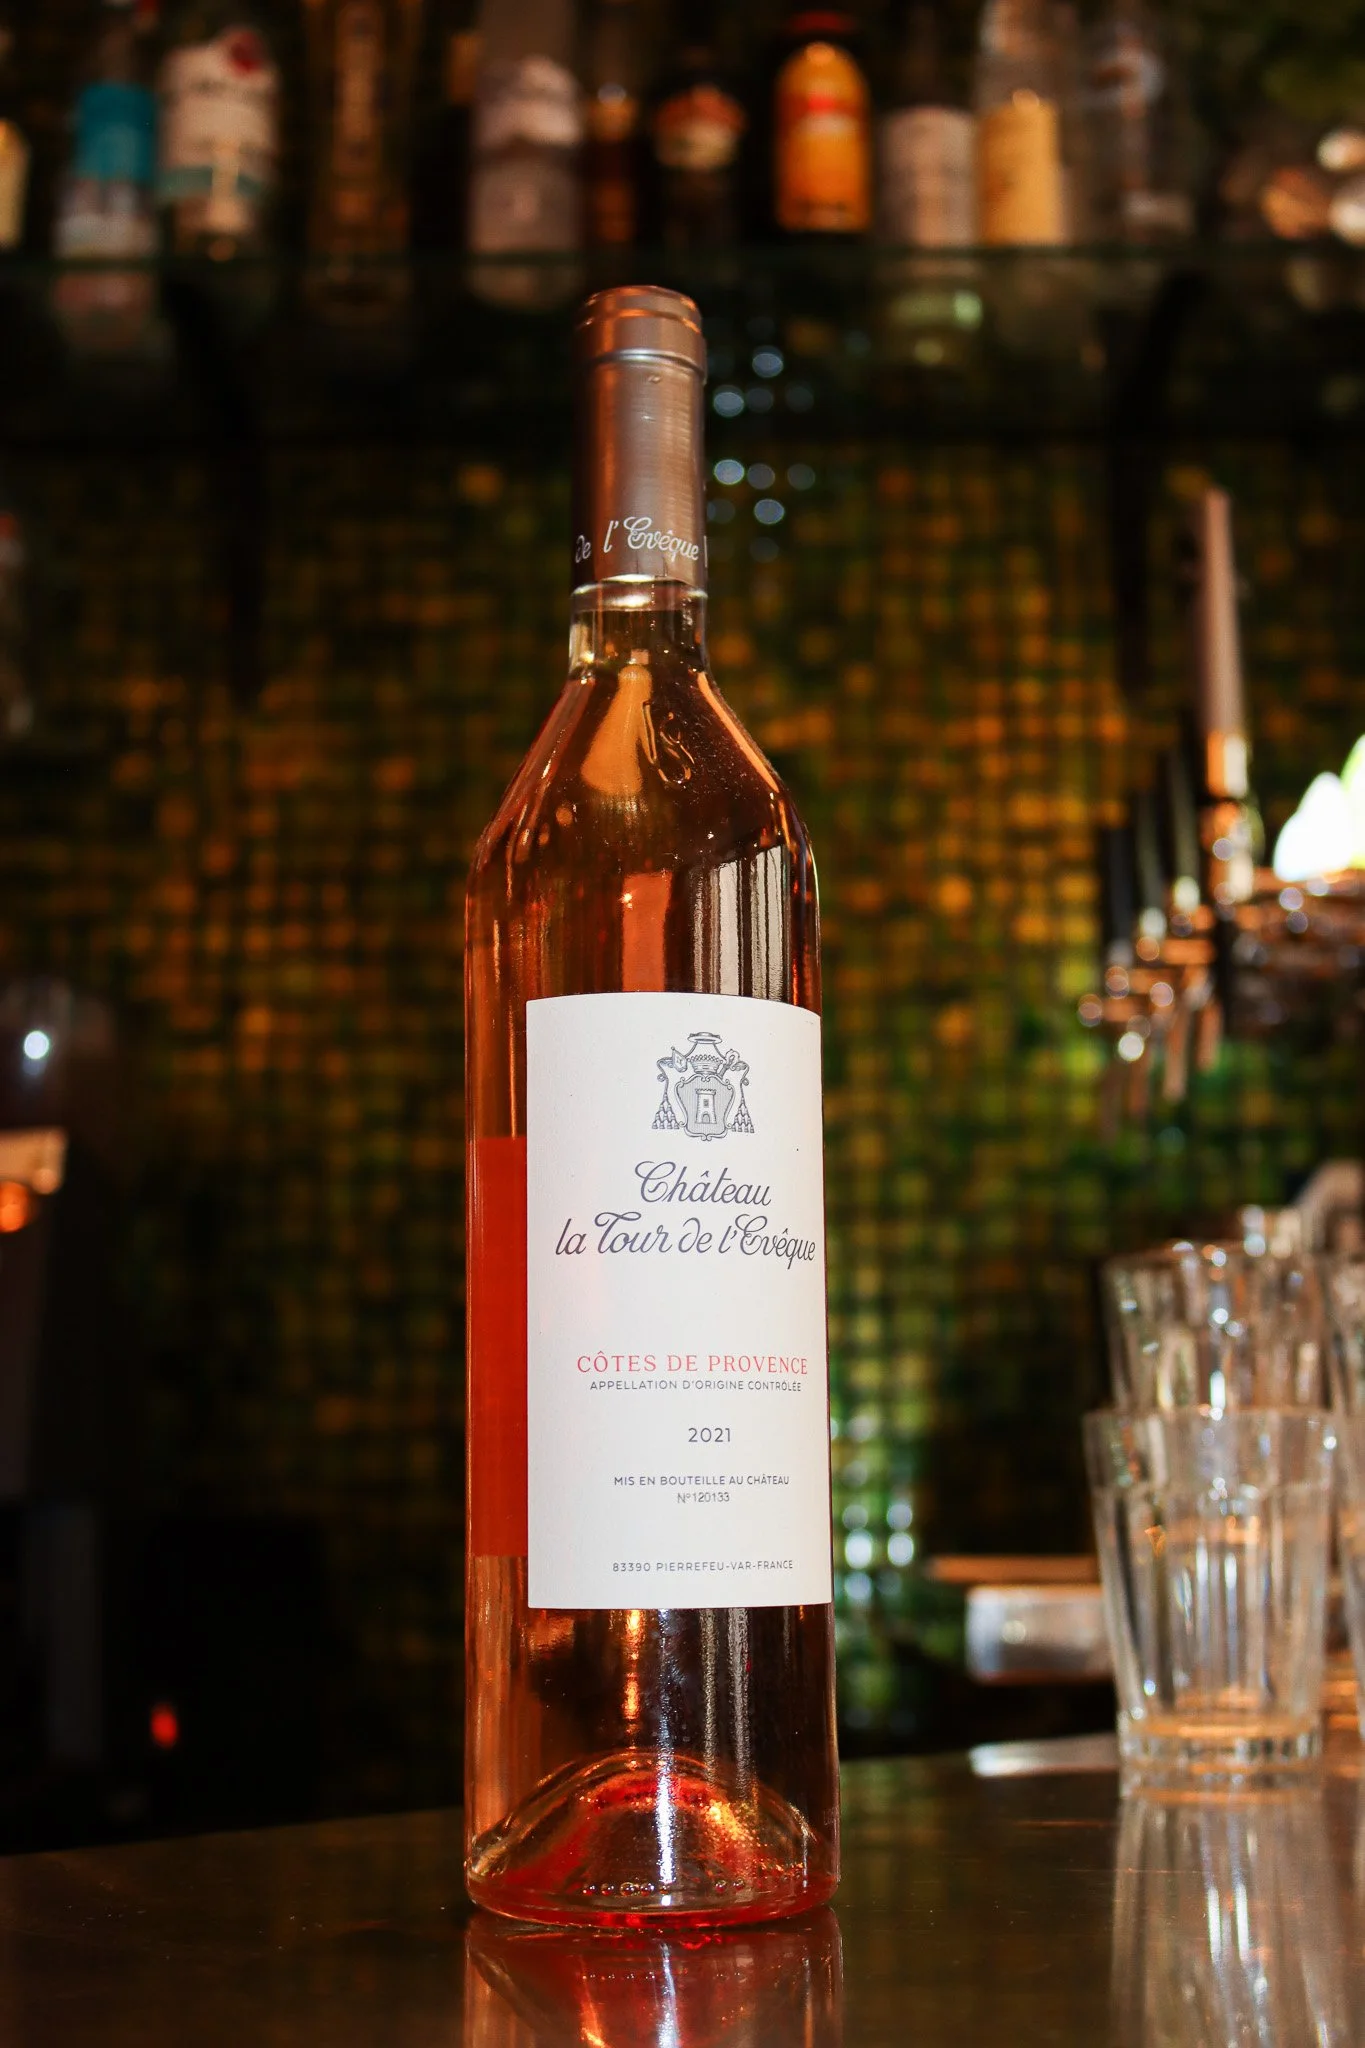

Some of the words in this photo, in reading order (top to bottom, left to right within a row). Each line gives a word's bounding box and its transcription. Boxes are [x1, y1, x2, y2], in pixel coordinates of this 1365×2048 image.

[635, 1160, 771, 1206] Château
[555, 1217, 587, 1256] la
[594, 1211, 672, 1255] Tour
[678, 1216, 713, 1254] de
[717, 1213, 816, 1270] l'Evêque
[577, 1350, 657, 1374] CÔTES
[667, 1354, 698, 1372] DE
[708, 1354, 808, 1375] PROVENCE
[589, 1379, 678, 1391] APPELLATION
[682, 1379, 744, 1390] D'ORIGINE
[747, 1380, 802, 1392] CONTRÔLÉE
[687, 1427, 731, 1443] 2021
[613, 1476, 635, 1486] MIS
[639, 1476, 656, 1486] EN
[660, 1475, 726, 1486] BOUTEILLE
[728, 1475, 744, 1485] AU
[746, 1473, 790, 1485] CHÂTEAU
[612, 1562, 651, 1573] 83390
[656, 1559, 793, 1572] PIERREFEU-VAR-FRANCE
